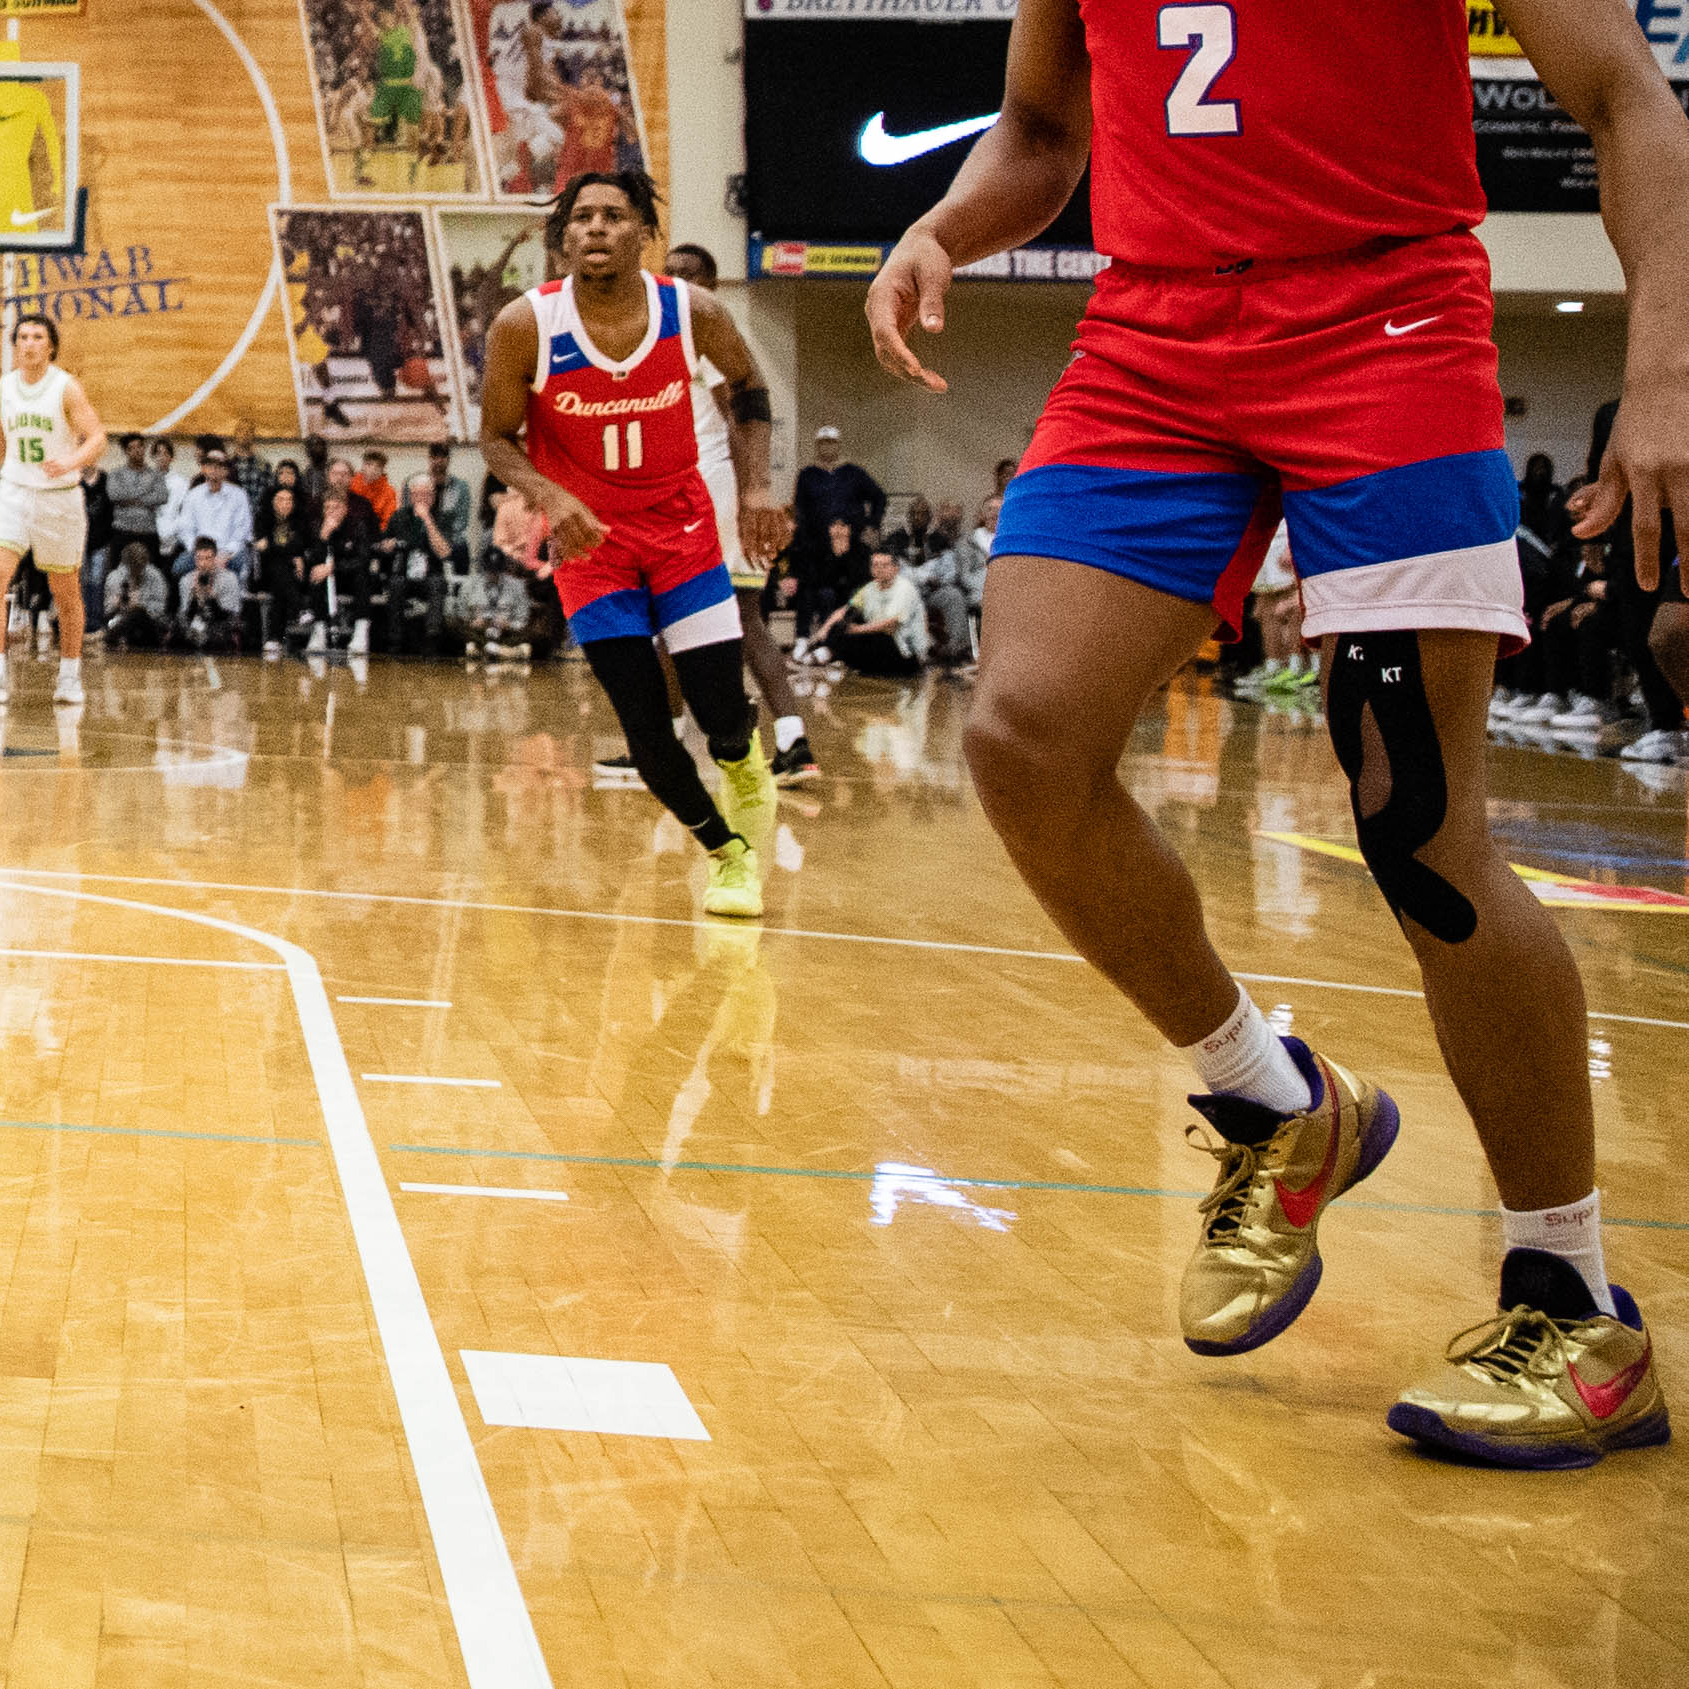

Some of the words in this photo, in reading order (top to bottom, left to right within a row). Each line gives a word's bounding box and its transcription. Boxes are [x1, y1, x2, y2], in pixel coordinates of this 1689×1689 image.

[1155, 1, 1243, 139] 2
[7, 412, 54, 434] LIONS
[17, 437, 45, 464] 15
[601, 419, 644, 472] 11
[1381, 666, 1403, 683] KT
